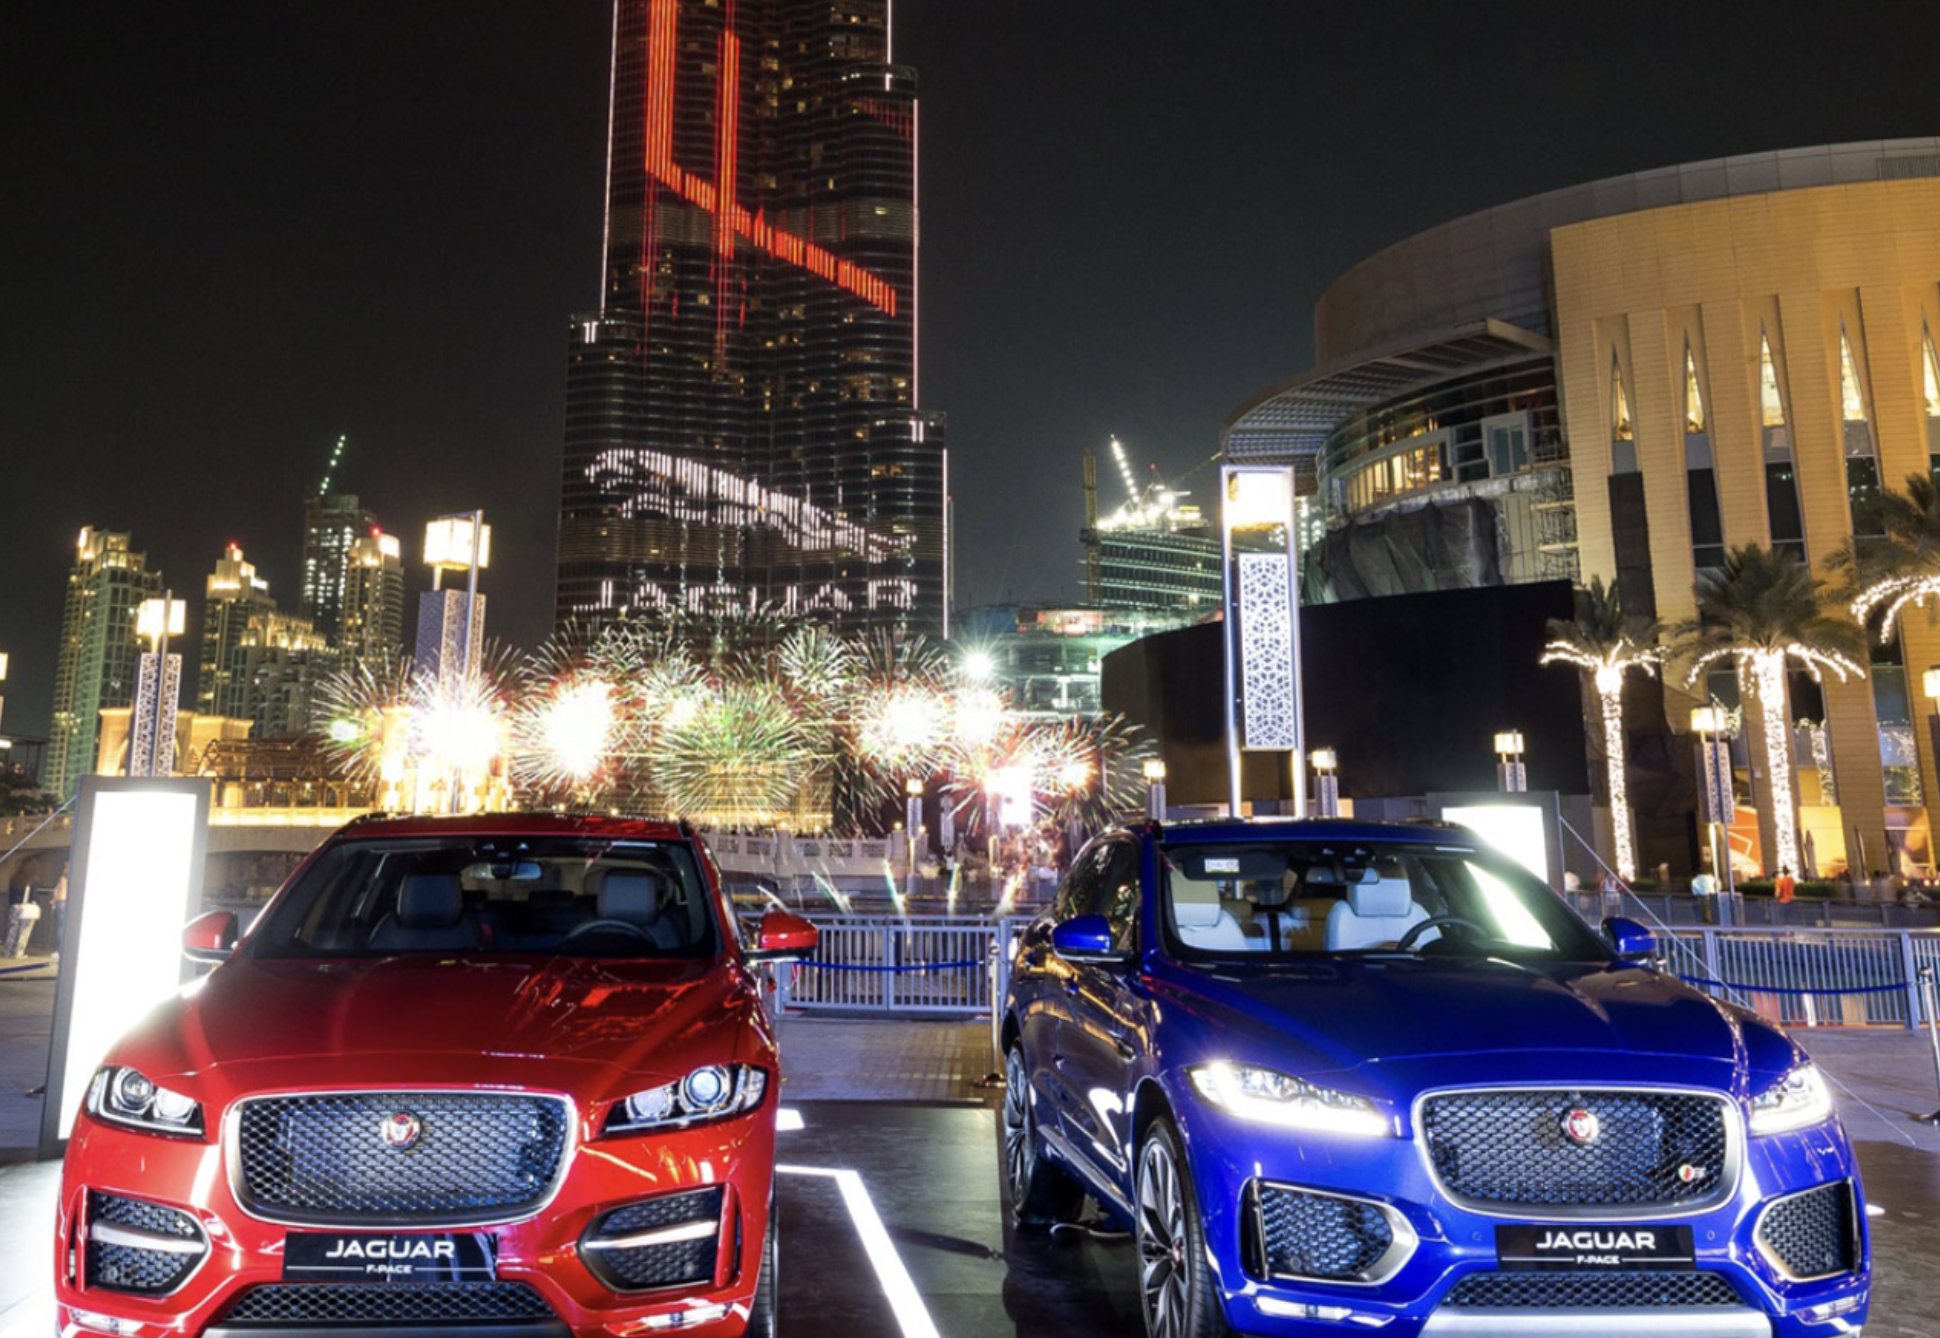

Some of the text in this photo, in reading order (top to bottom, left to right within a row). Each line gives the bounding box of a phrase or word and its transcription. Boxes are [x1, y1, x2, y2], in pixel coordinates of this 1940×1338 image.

[573, 579, 917, 617] JAGUAR
[325, 1240, 455, 1258] JAGUAR
[1536, 1231, 1656, 1249] JAGUAR
[365, 1264, 412, 1274] F-PACE
[1576, 1255, 1620, 1265] F-PACE
